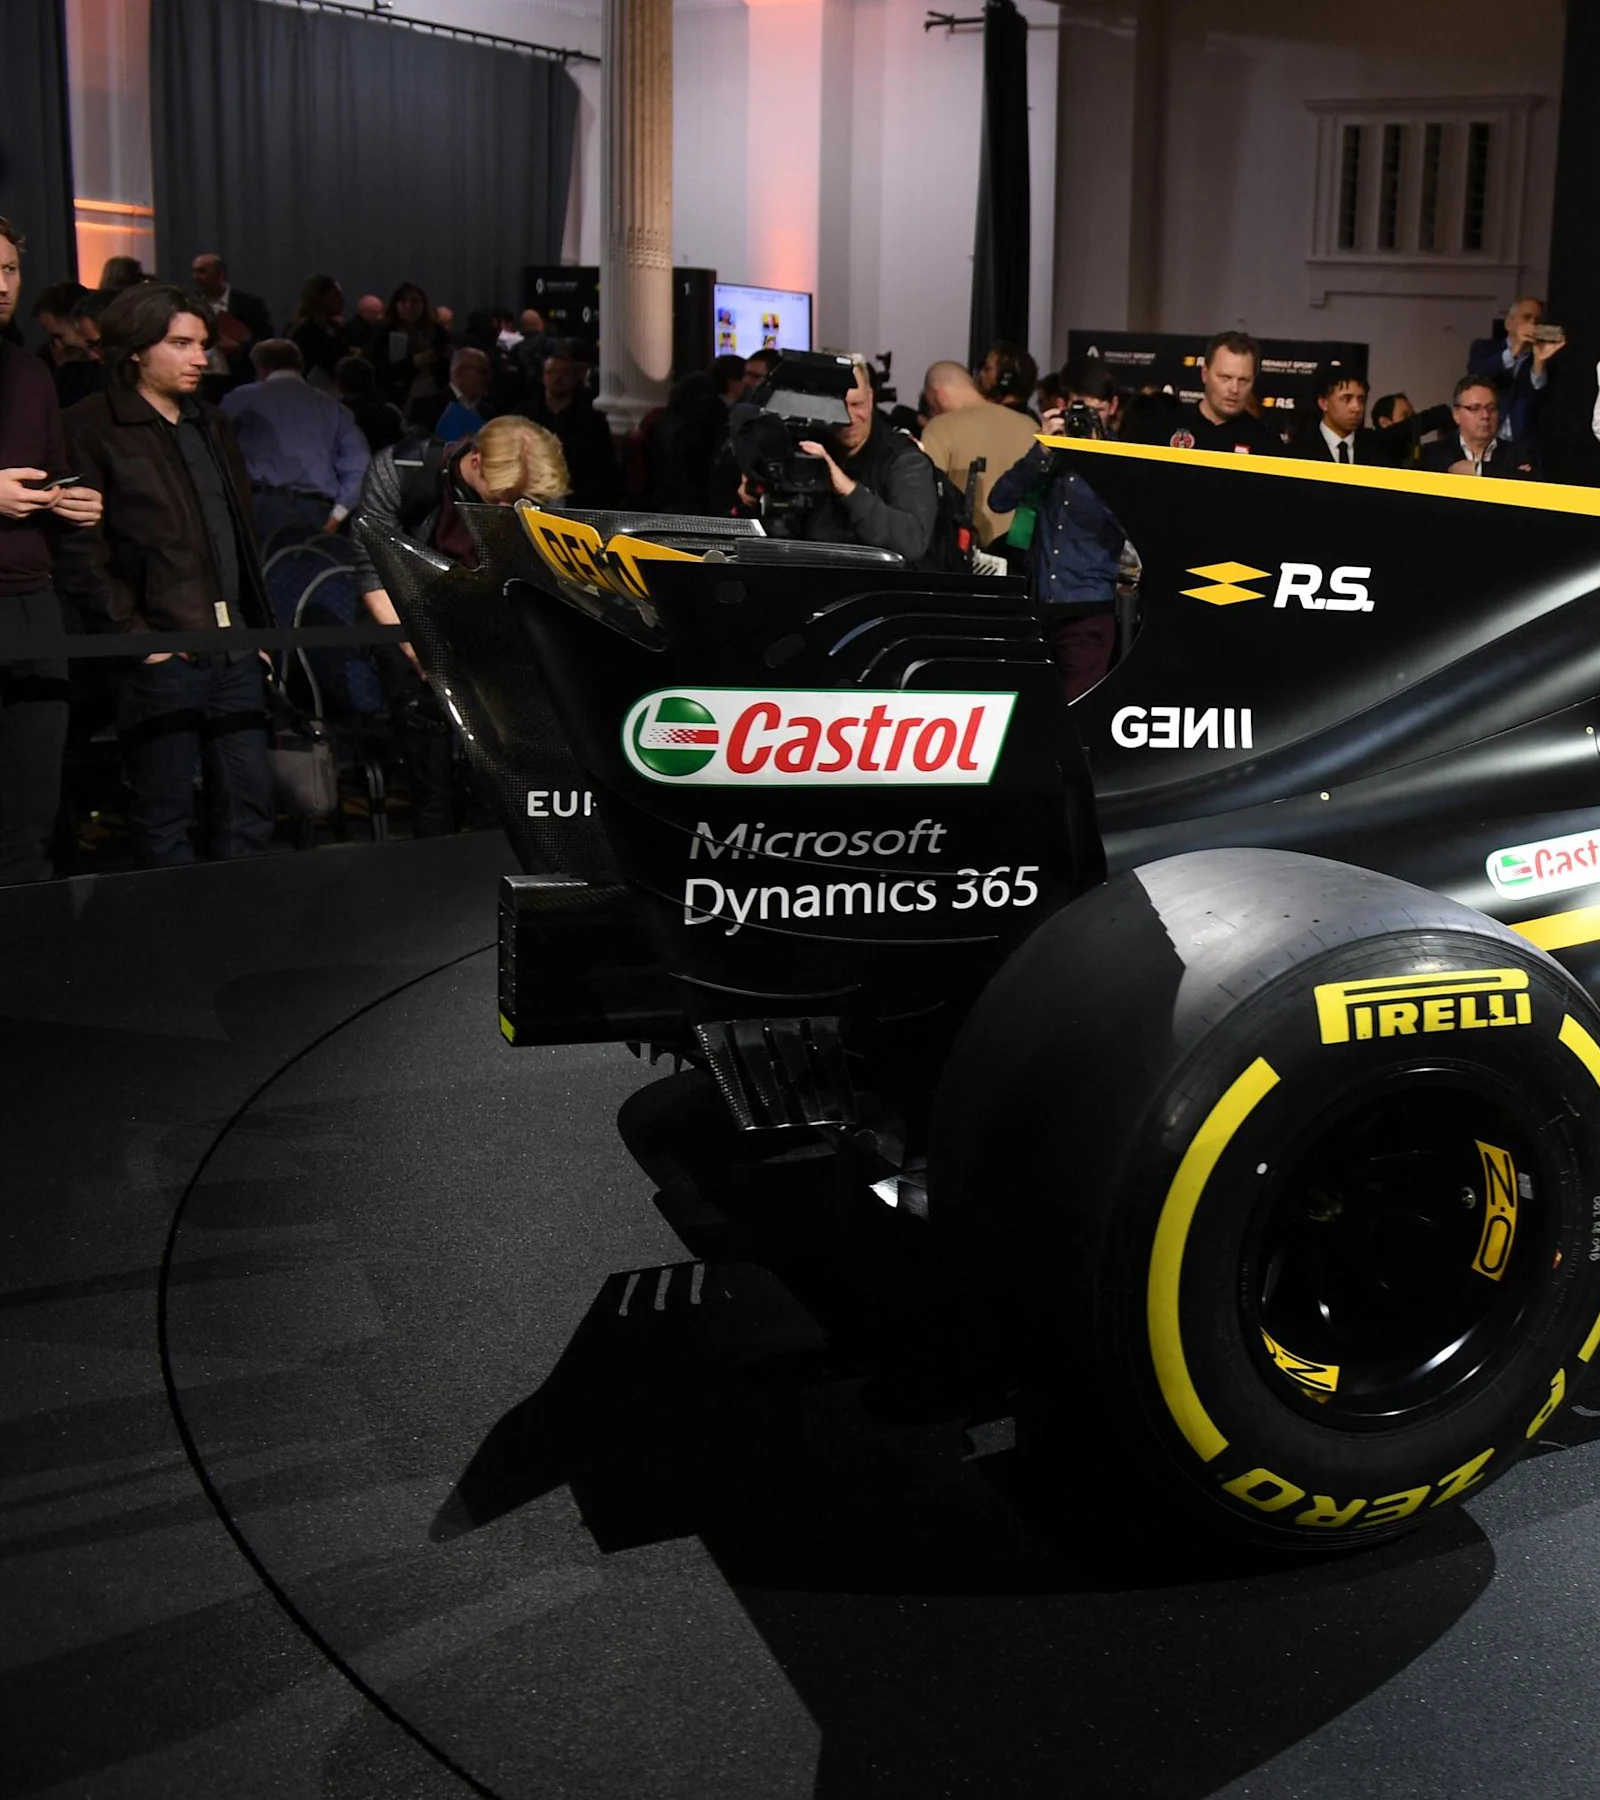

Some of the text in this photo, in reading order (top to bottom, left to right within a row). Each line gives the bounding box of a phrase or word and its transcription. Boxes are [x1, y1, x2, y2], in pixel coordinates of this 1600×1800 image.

[1273, 562, 1375, 612] R.S.
[725, 701, 985, 774] Castrol
[689, 819, 947, 860] Microsoft
[684, 866, 1039, 936] Dynamics 365
[1314, 968, 1532, 1044] PIRELLI
[1221, 1447, 1496, 1529] ZERO
